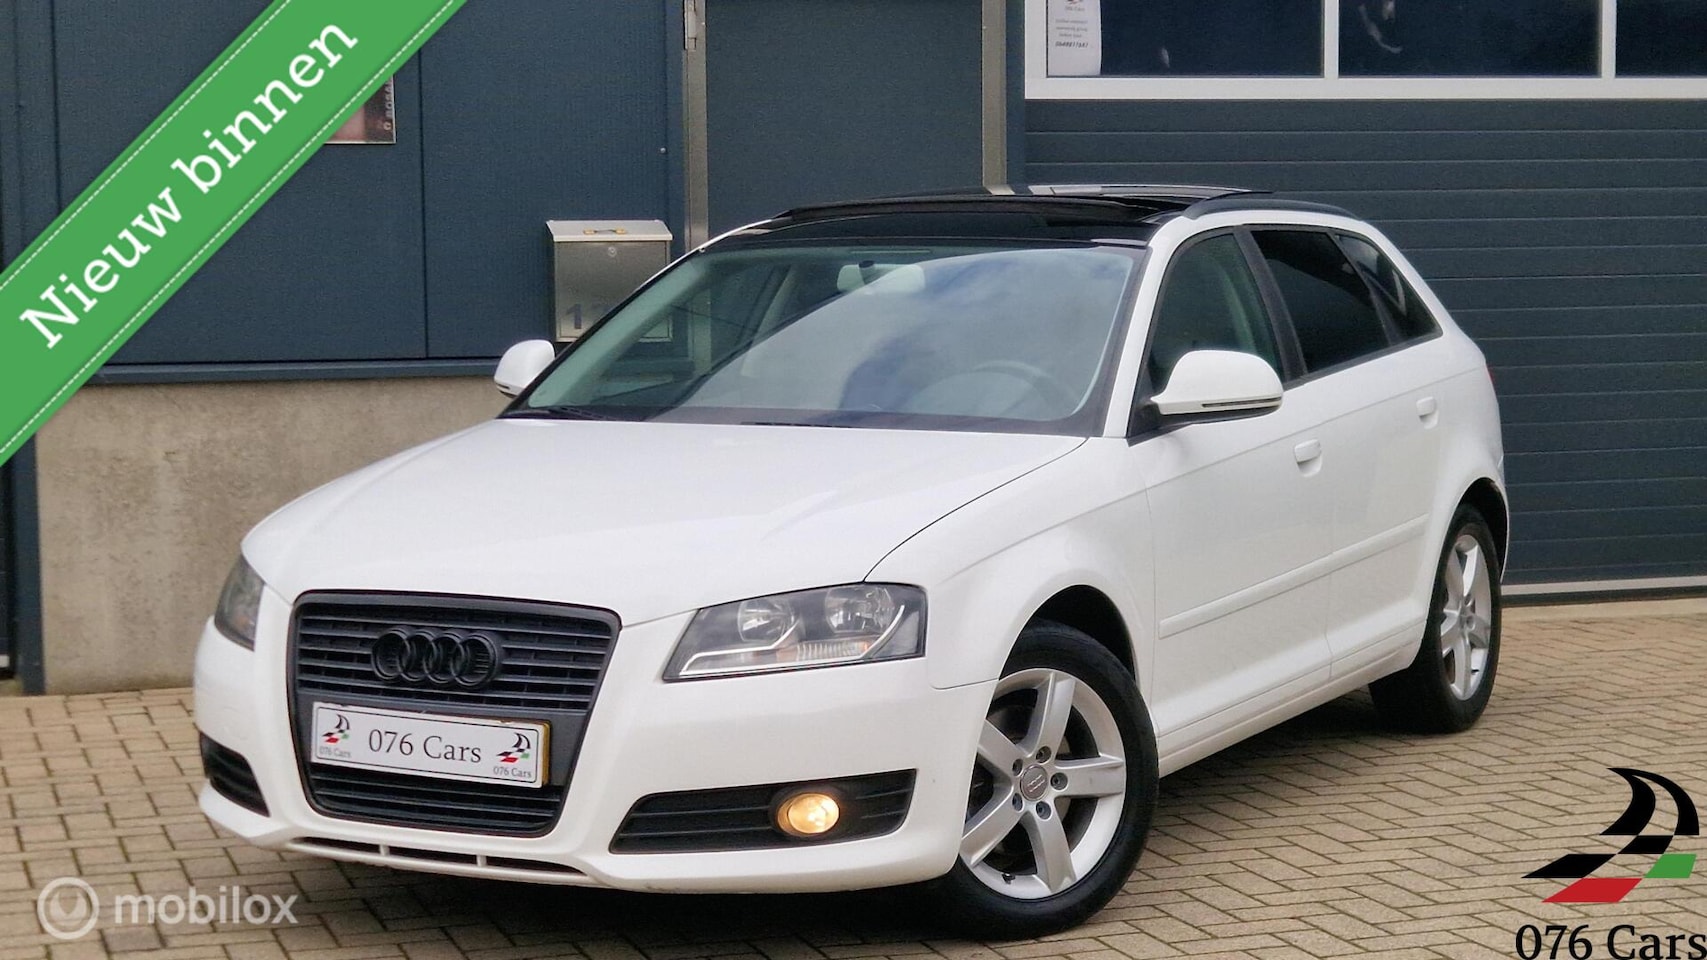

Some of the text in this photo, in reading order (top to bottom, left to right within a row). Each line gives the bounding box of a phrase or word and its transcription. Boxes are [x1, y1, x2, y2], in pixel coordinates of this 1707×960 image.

[368, 728, 482, 764] 076 Cars
[492, 765, 532, 779] 076 Cars
